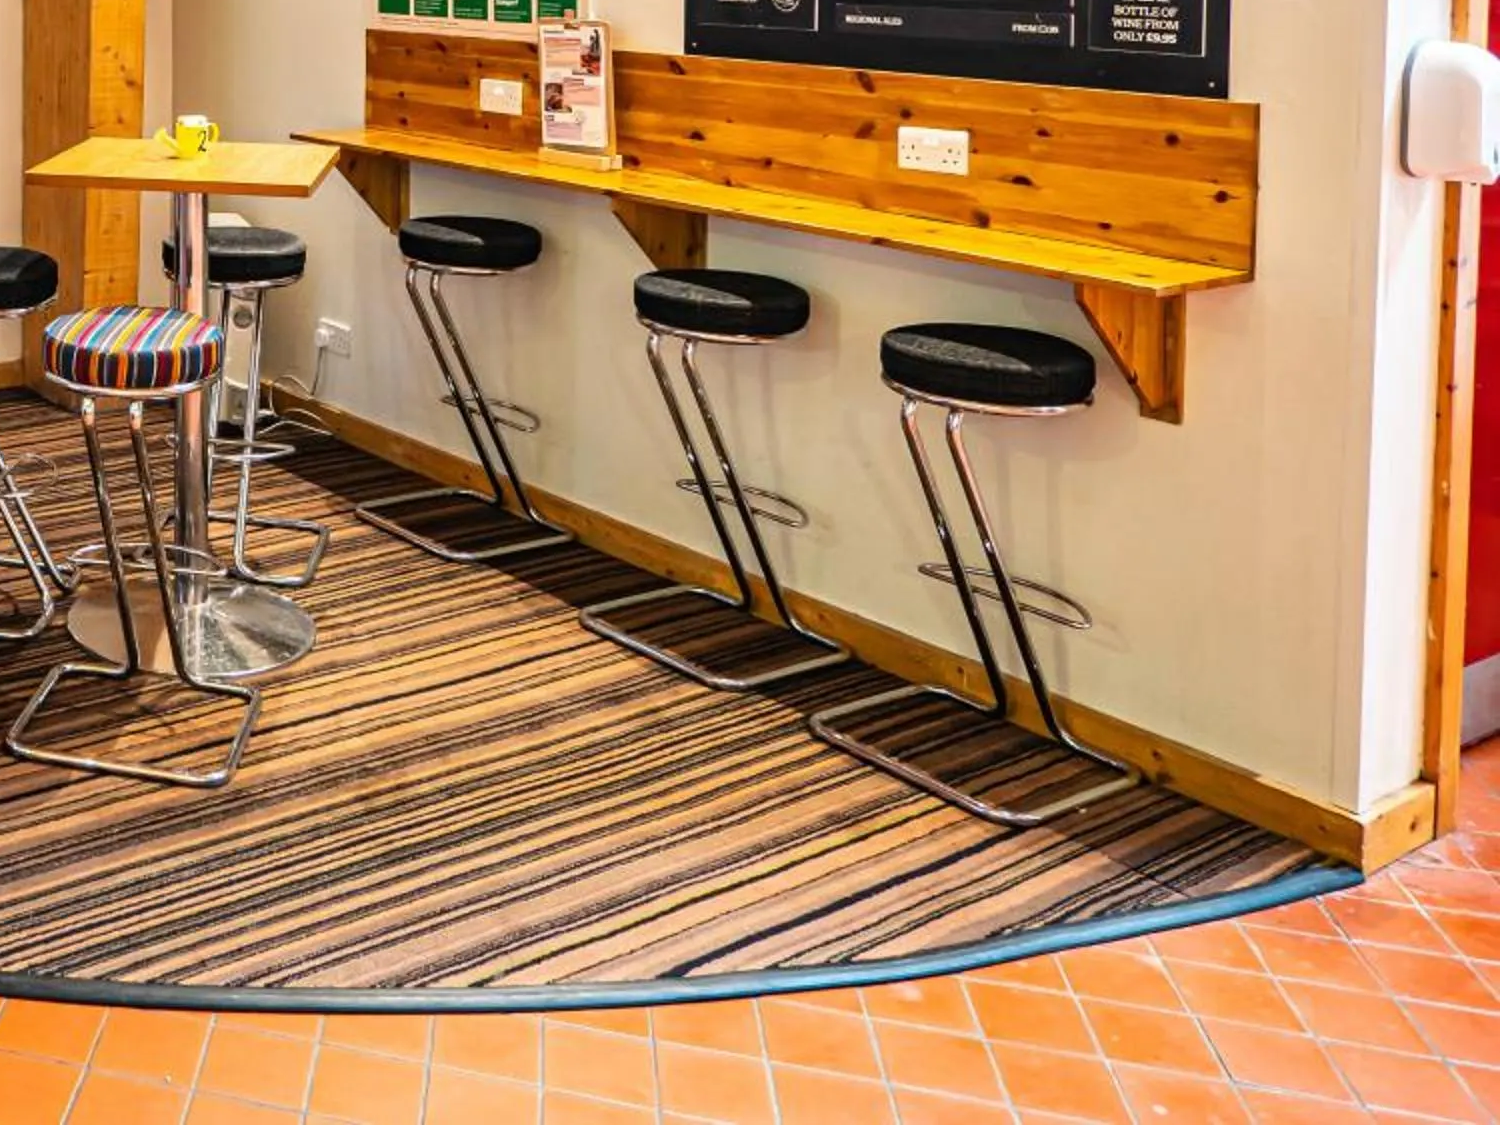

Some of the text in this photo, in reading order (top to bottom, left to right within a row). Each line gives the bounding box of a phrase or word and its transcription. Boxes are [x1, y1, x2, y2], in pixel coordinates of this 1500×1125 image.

[1113, 4, 1178, 18] BOTTLE OF
[1111, 17, 1179, 30] WINE FROM
[1113, 30, 1177, 44] ONLY £9.95
